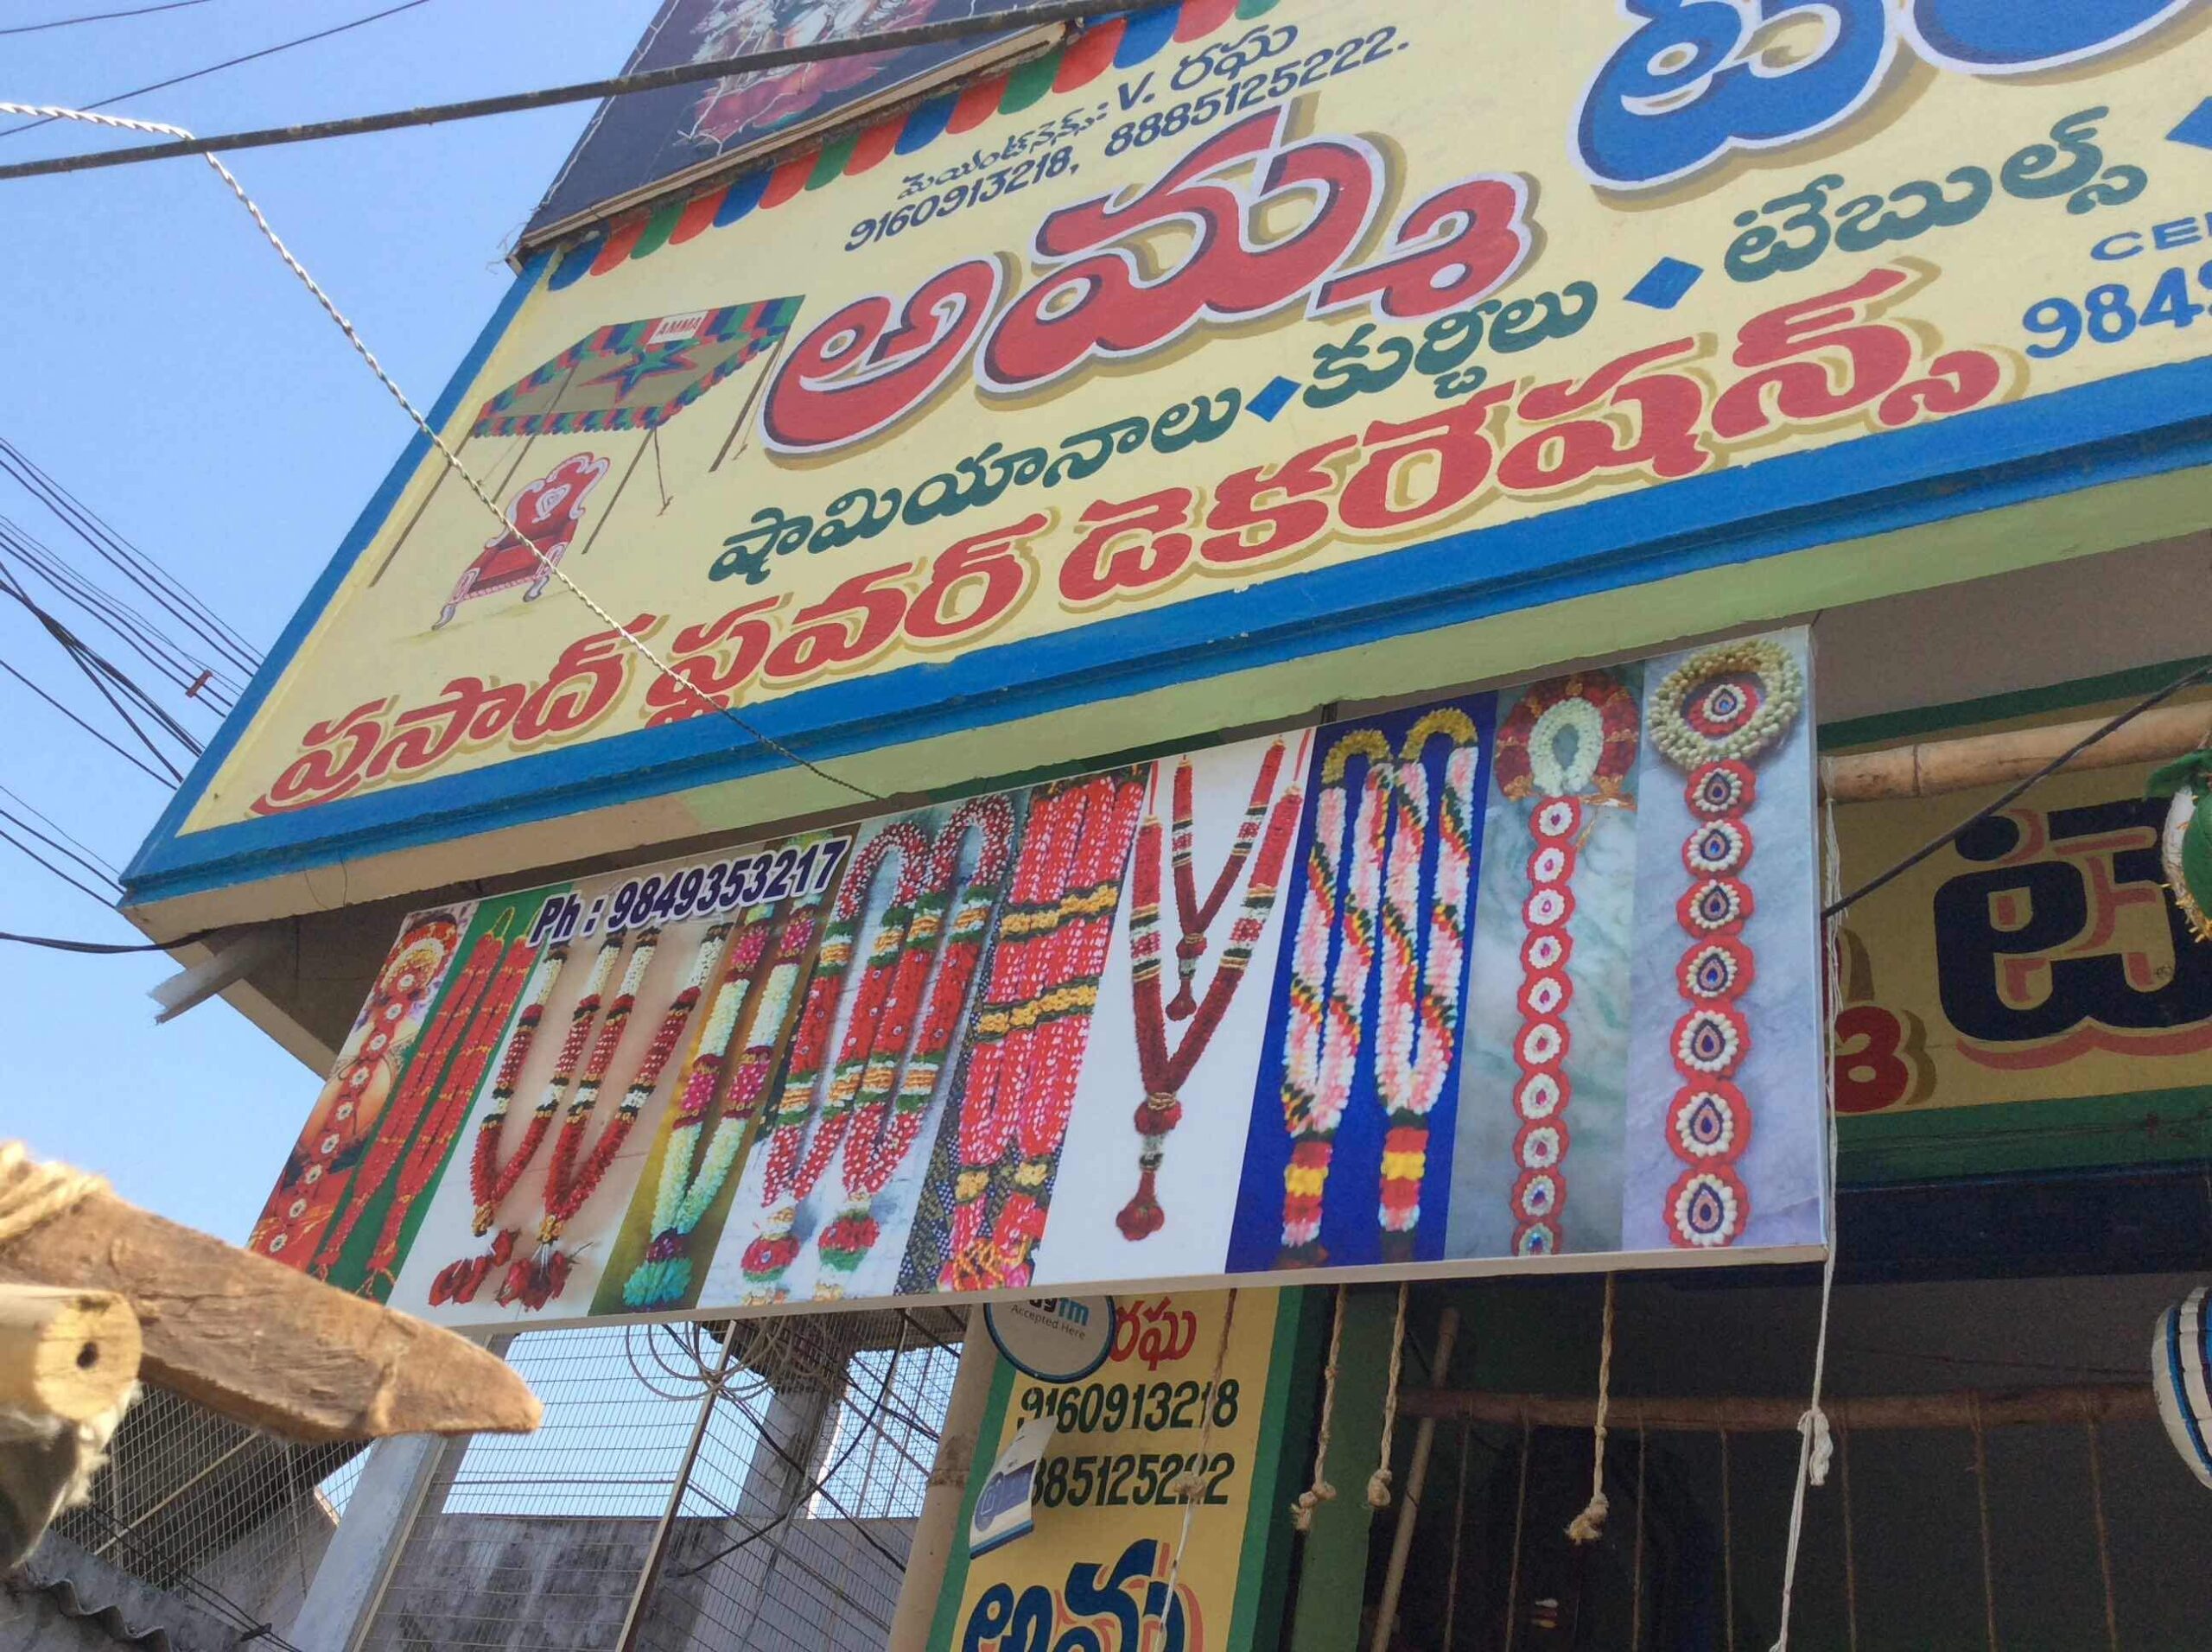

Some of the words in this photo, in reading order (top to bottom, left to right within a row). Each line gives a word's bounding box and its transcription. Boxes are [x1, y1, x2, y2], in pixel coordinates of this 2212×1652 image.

[1170, 24, 1299, 91] రఘు
[845, 145, 1079, 252] 9160913218,
[1104, 26, 1409, 157] 8885125222.
[1725, 105, 2148, 283] టేబుల్స్
[760, 102, 1531, 454] అమ్మ
[2090, 211, 2212, 261] CE
[2022, 259, 2212, 359] 984
[709, 387, 1242, 584] షామియానాలు
[607, 841, 848, 928] 9849353217
